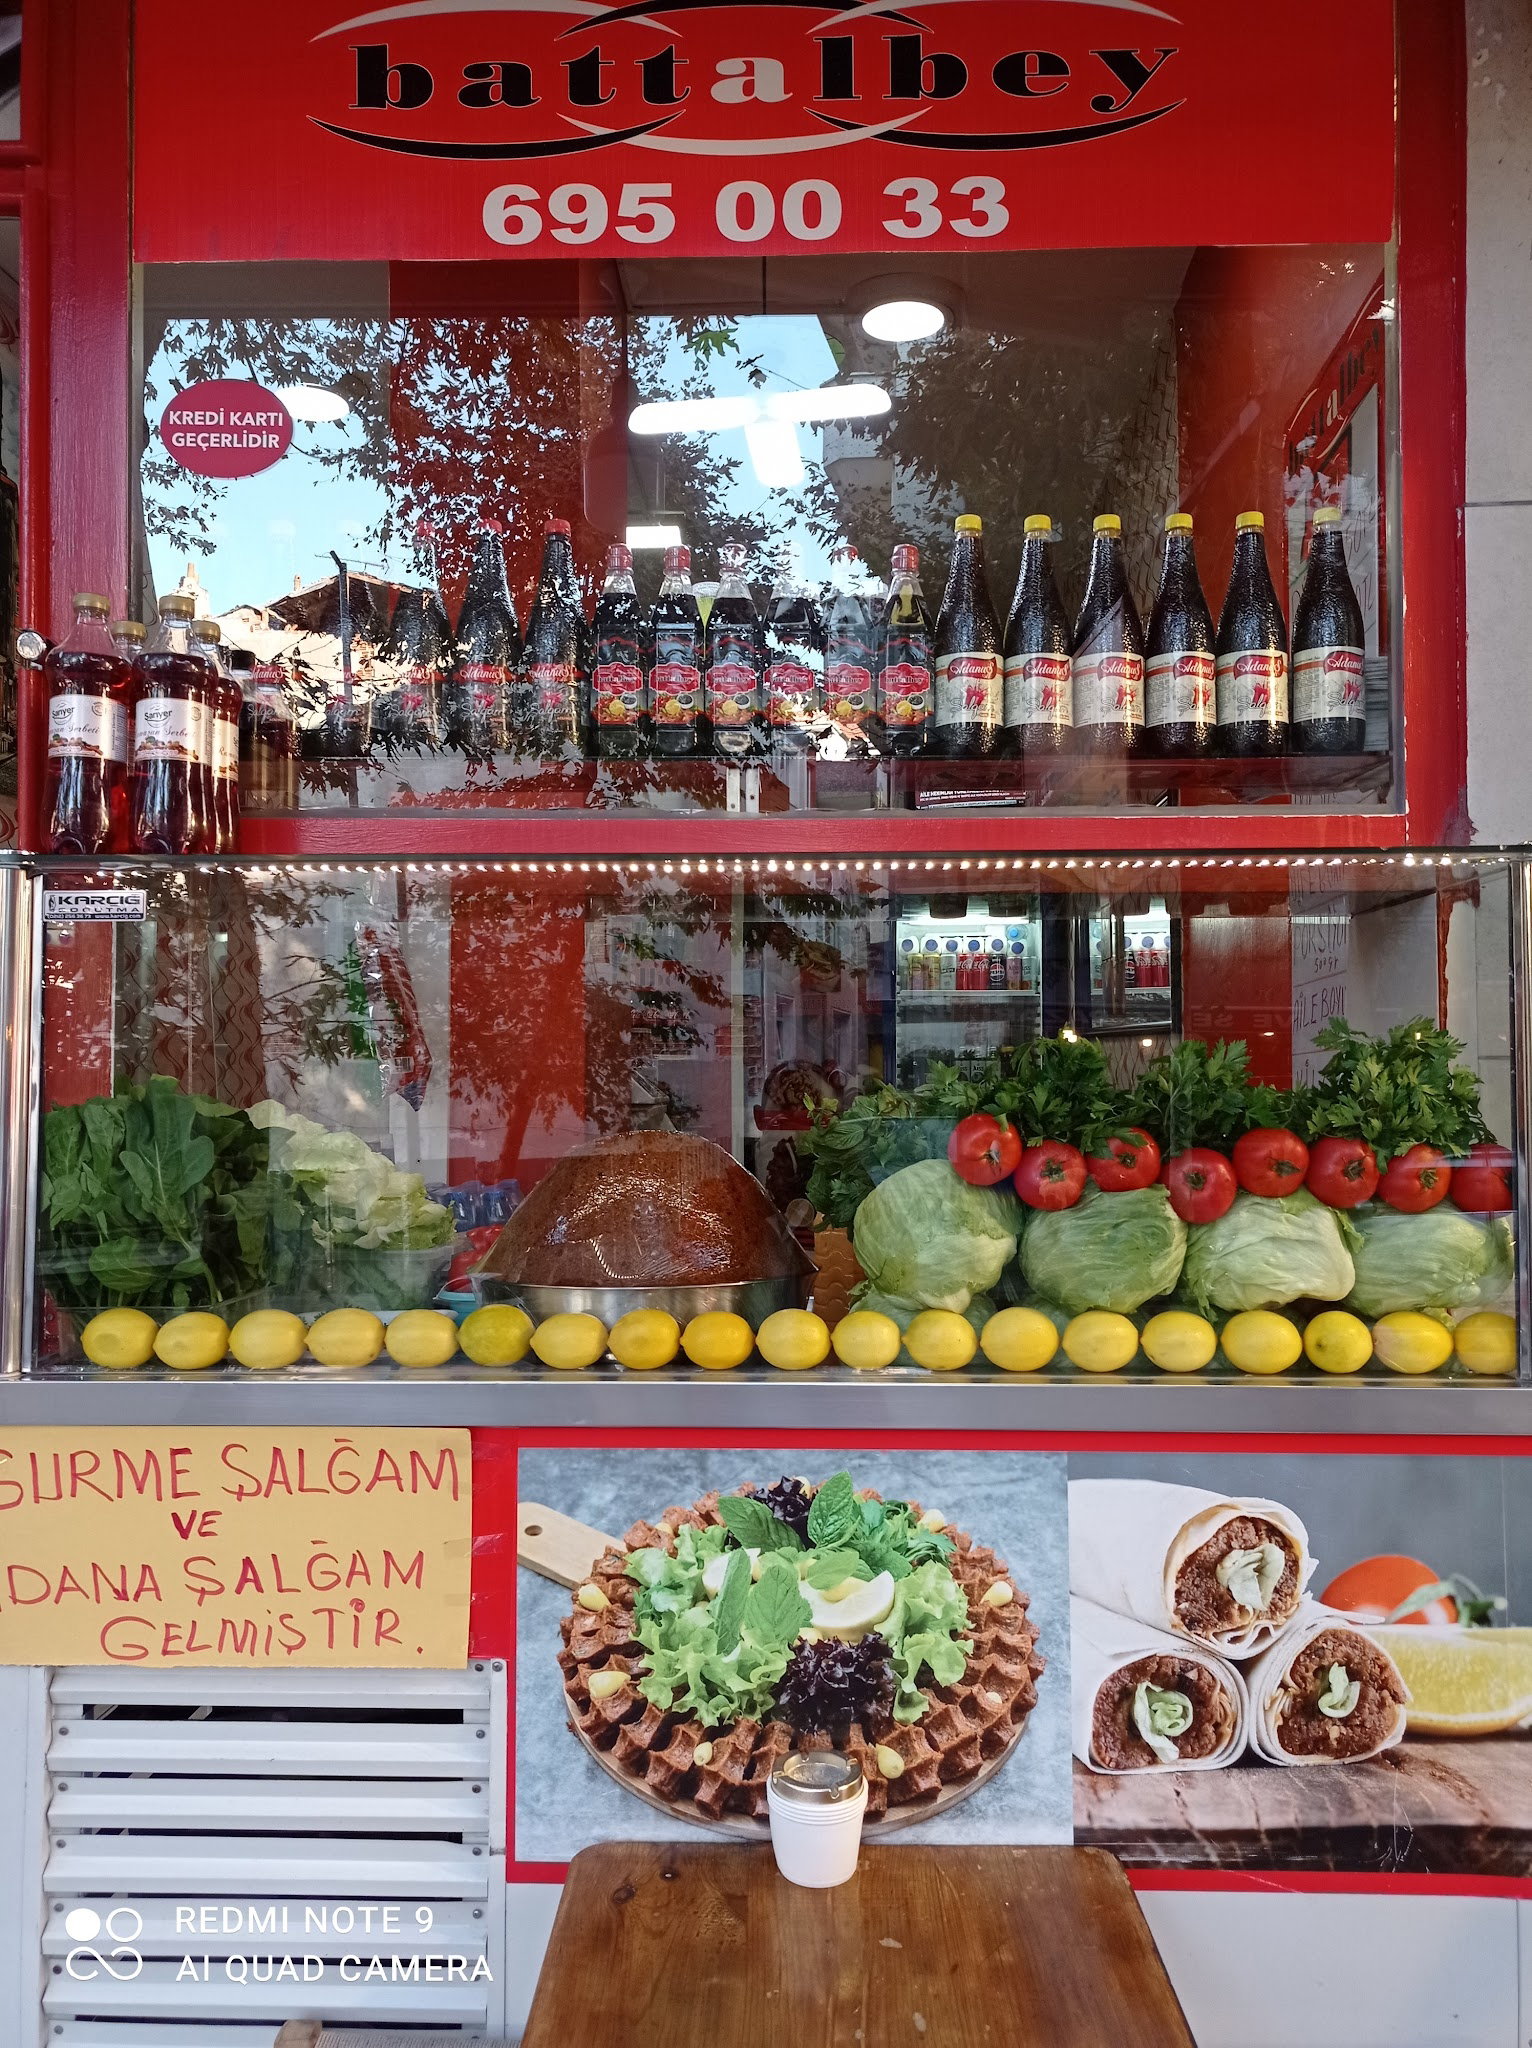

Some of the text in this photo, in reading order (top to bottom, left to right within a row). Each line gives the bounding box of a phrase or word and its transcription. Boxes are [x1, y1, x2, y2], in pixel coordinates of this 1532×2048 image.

[348, 34, 1180, 114] battalbey
[482, 176, 1010, 245] 695 00 33
[169, 408, 283, 427] KREDİ KARTI
[171, 430, 280, 452] GEÇERLİDİR
[171, 1510, 223, 1540] VE
[0, 1561, 162, 1612] DANA
